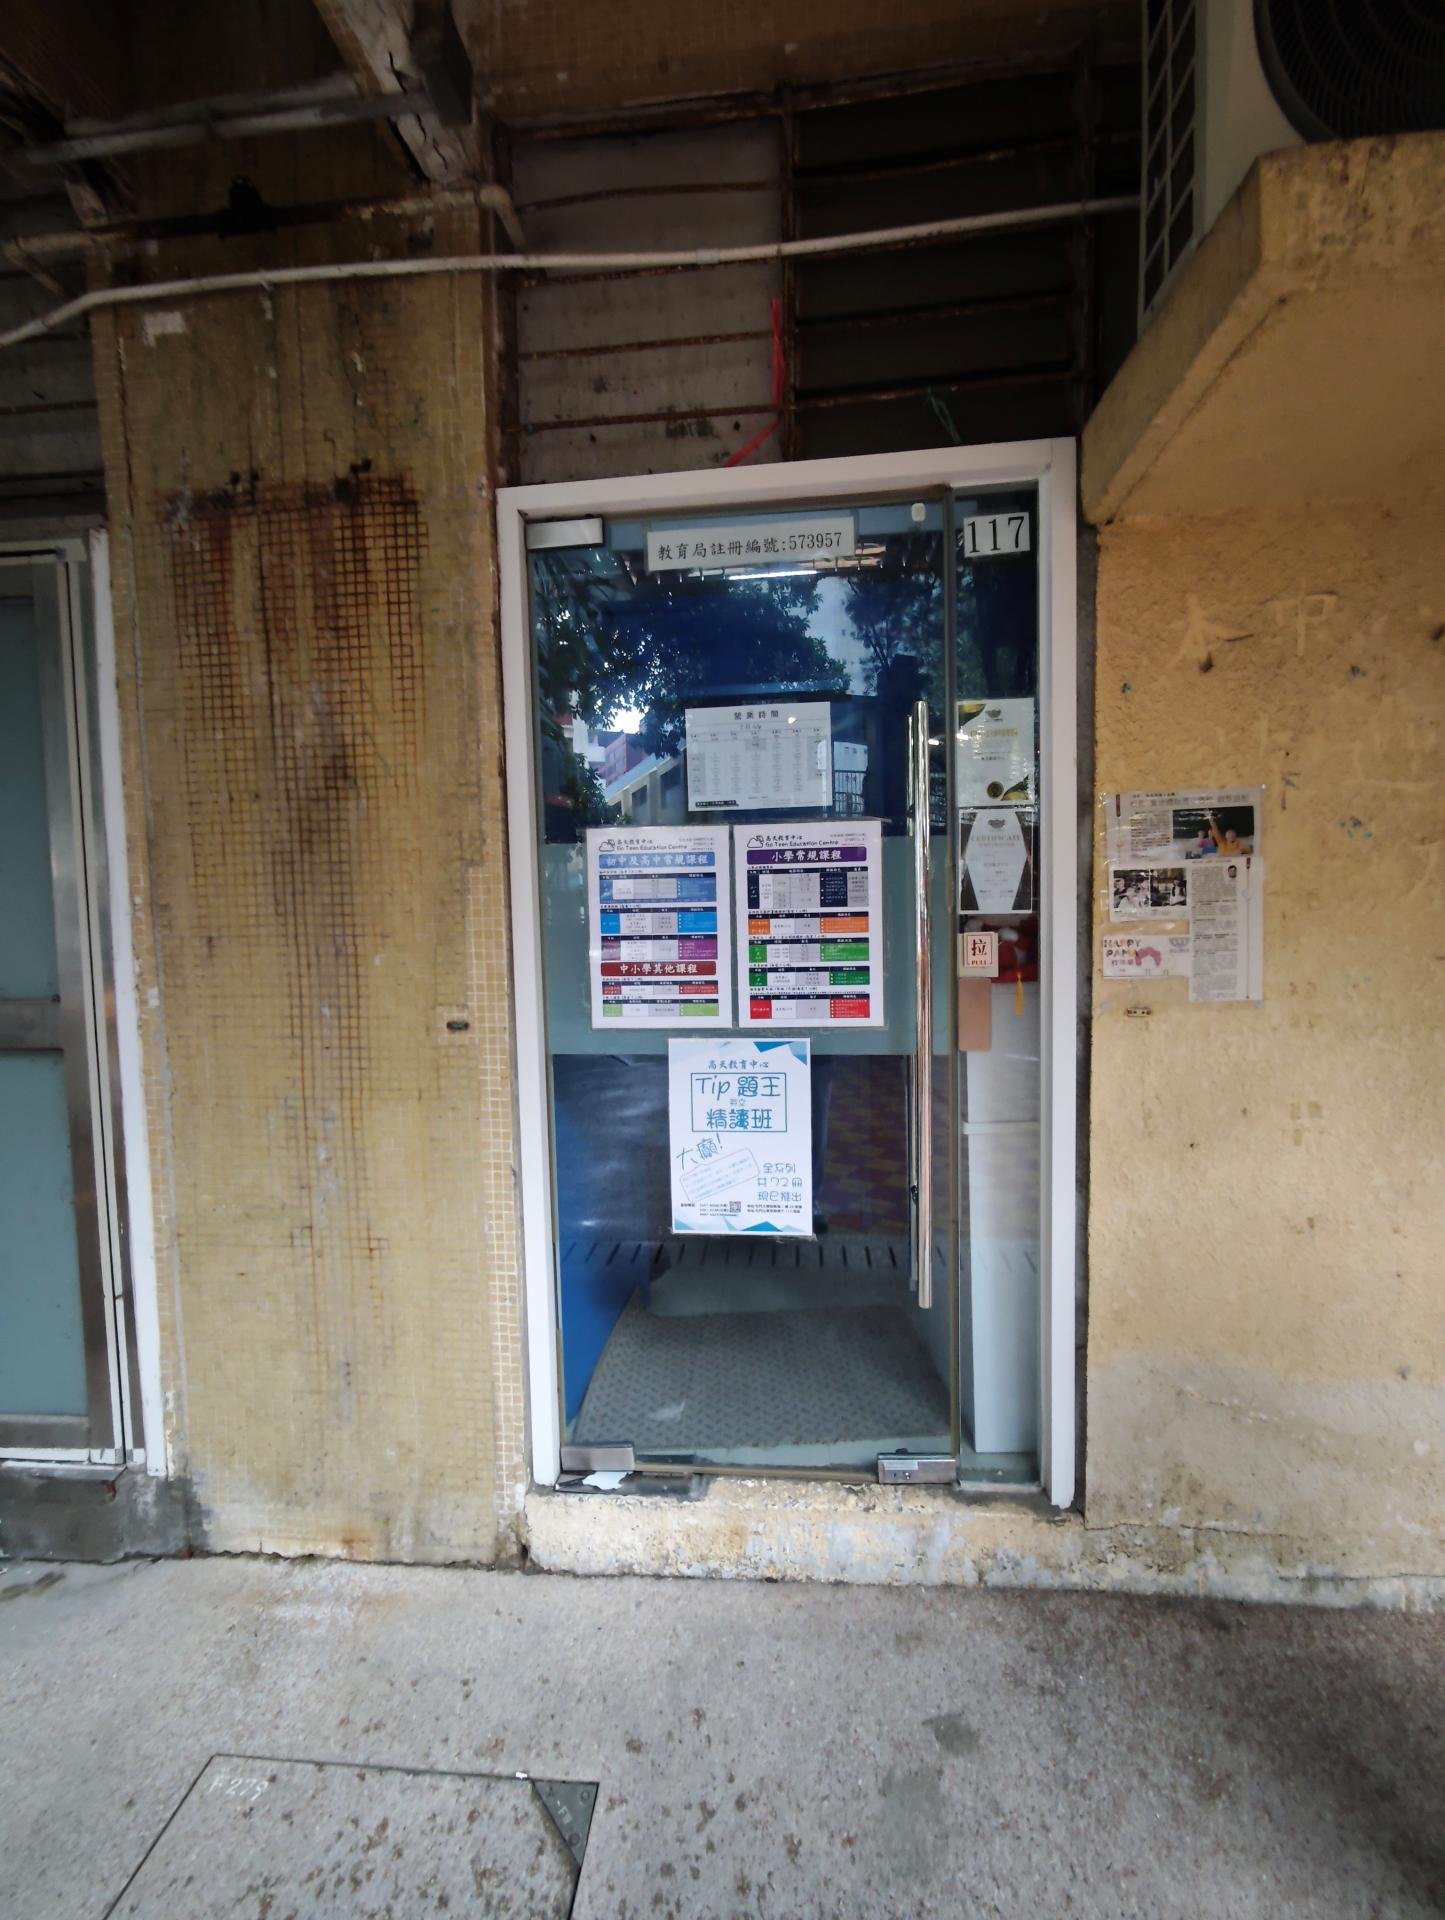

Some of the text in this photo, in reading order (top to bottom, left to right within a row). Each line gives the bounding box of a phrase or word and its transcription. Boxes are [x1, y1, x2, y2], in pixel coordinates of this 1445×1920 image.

[968, 516, 1025, 553] 117
[658, 532, 842, 560] 教育局註冊編號:573957
[607, 854, 709, 866] 初中及高中常規課程
[771, 850, 842, 862] 小學常規課程
[971, 939, 987, 956] 拉
[620, 963, 698, 974] 中小學其他課程
[708, 1059, 769, 1070] 高天教育中心
[695, 1074, 781, 1101] Tip 題王
[706, 1108, 773, 1129] 精讀班
[762, 1162, 796, 1174] 全系列
[757, 1190, 802, 1202] 現已推出
